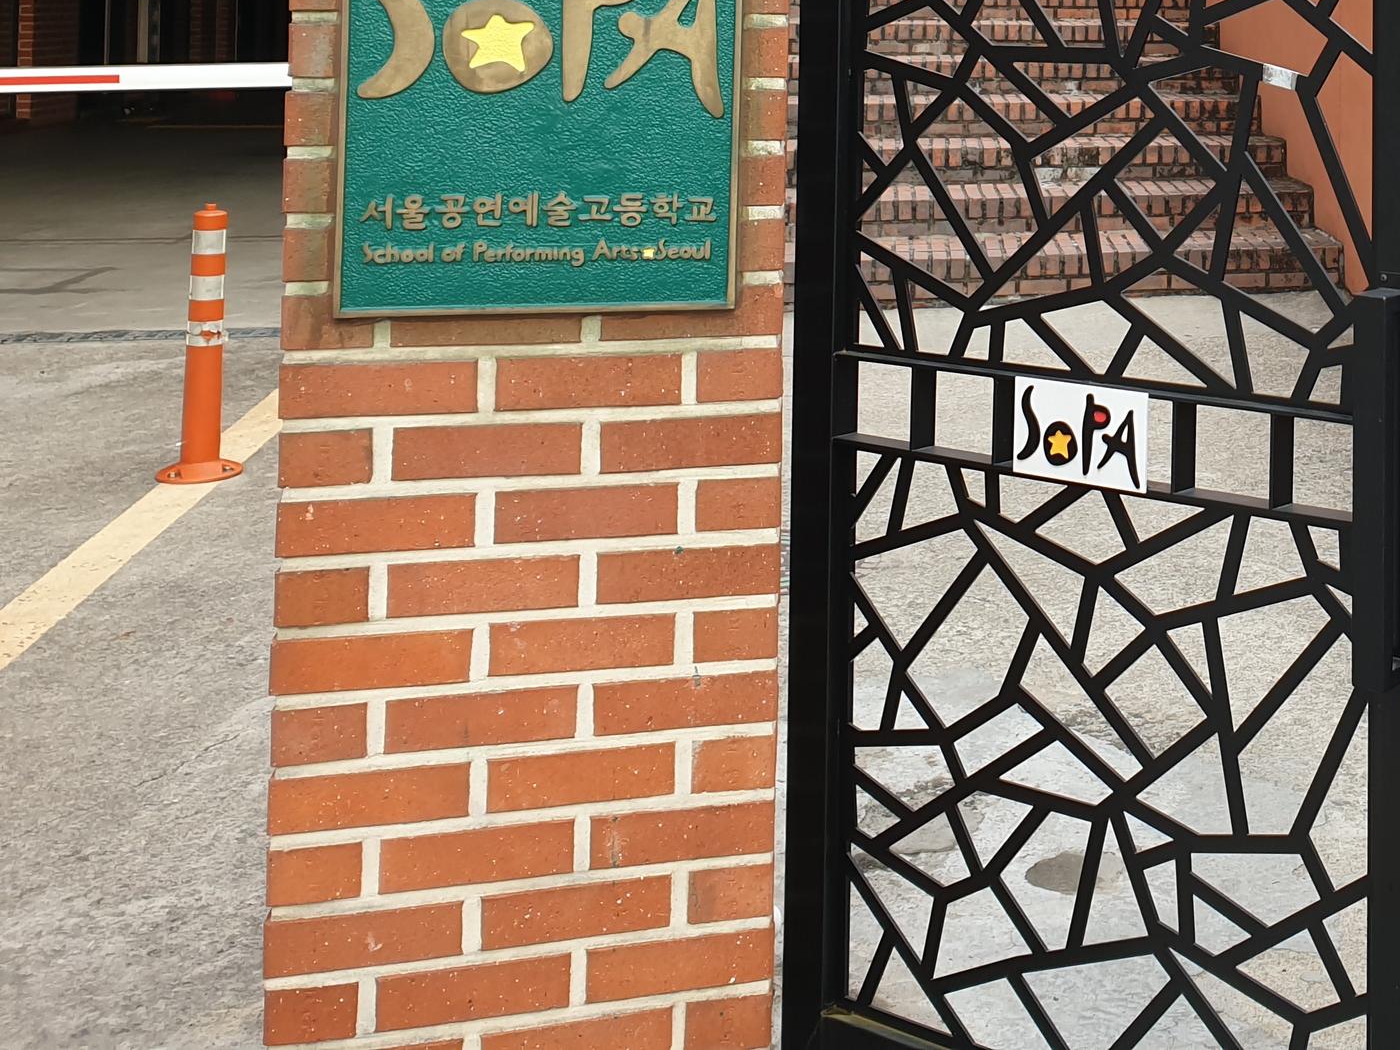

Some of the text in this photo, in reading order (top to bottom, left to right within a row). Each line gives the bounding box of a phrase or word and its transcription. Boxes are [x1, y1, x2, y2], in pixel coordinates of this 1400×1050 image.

[359, 190, 718, 230] 서울공연예술고등학교
[363, 241, 435, 264] School
[441, 241, 466, 262] of
[472, 239, 585, 267] Performing
